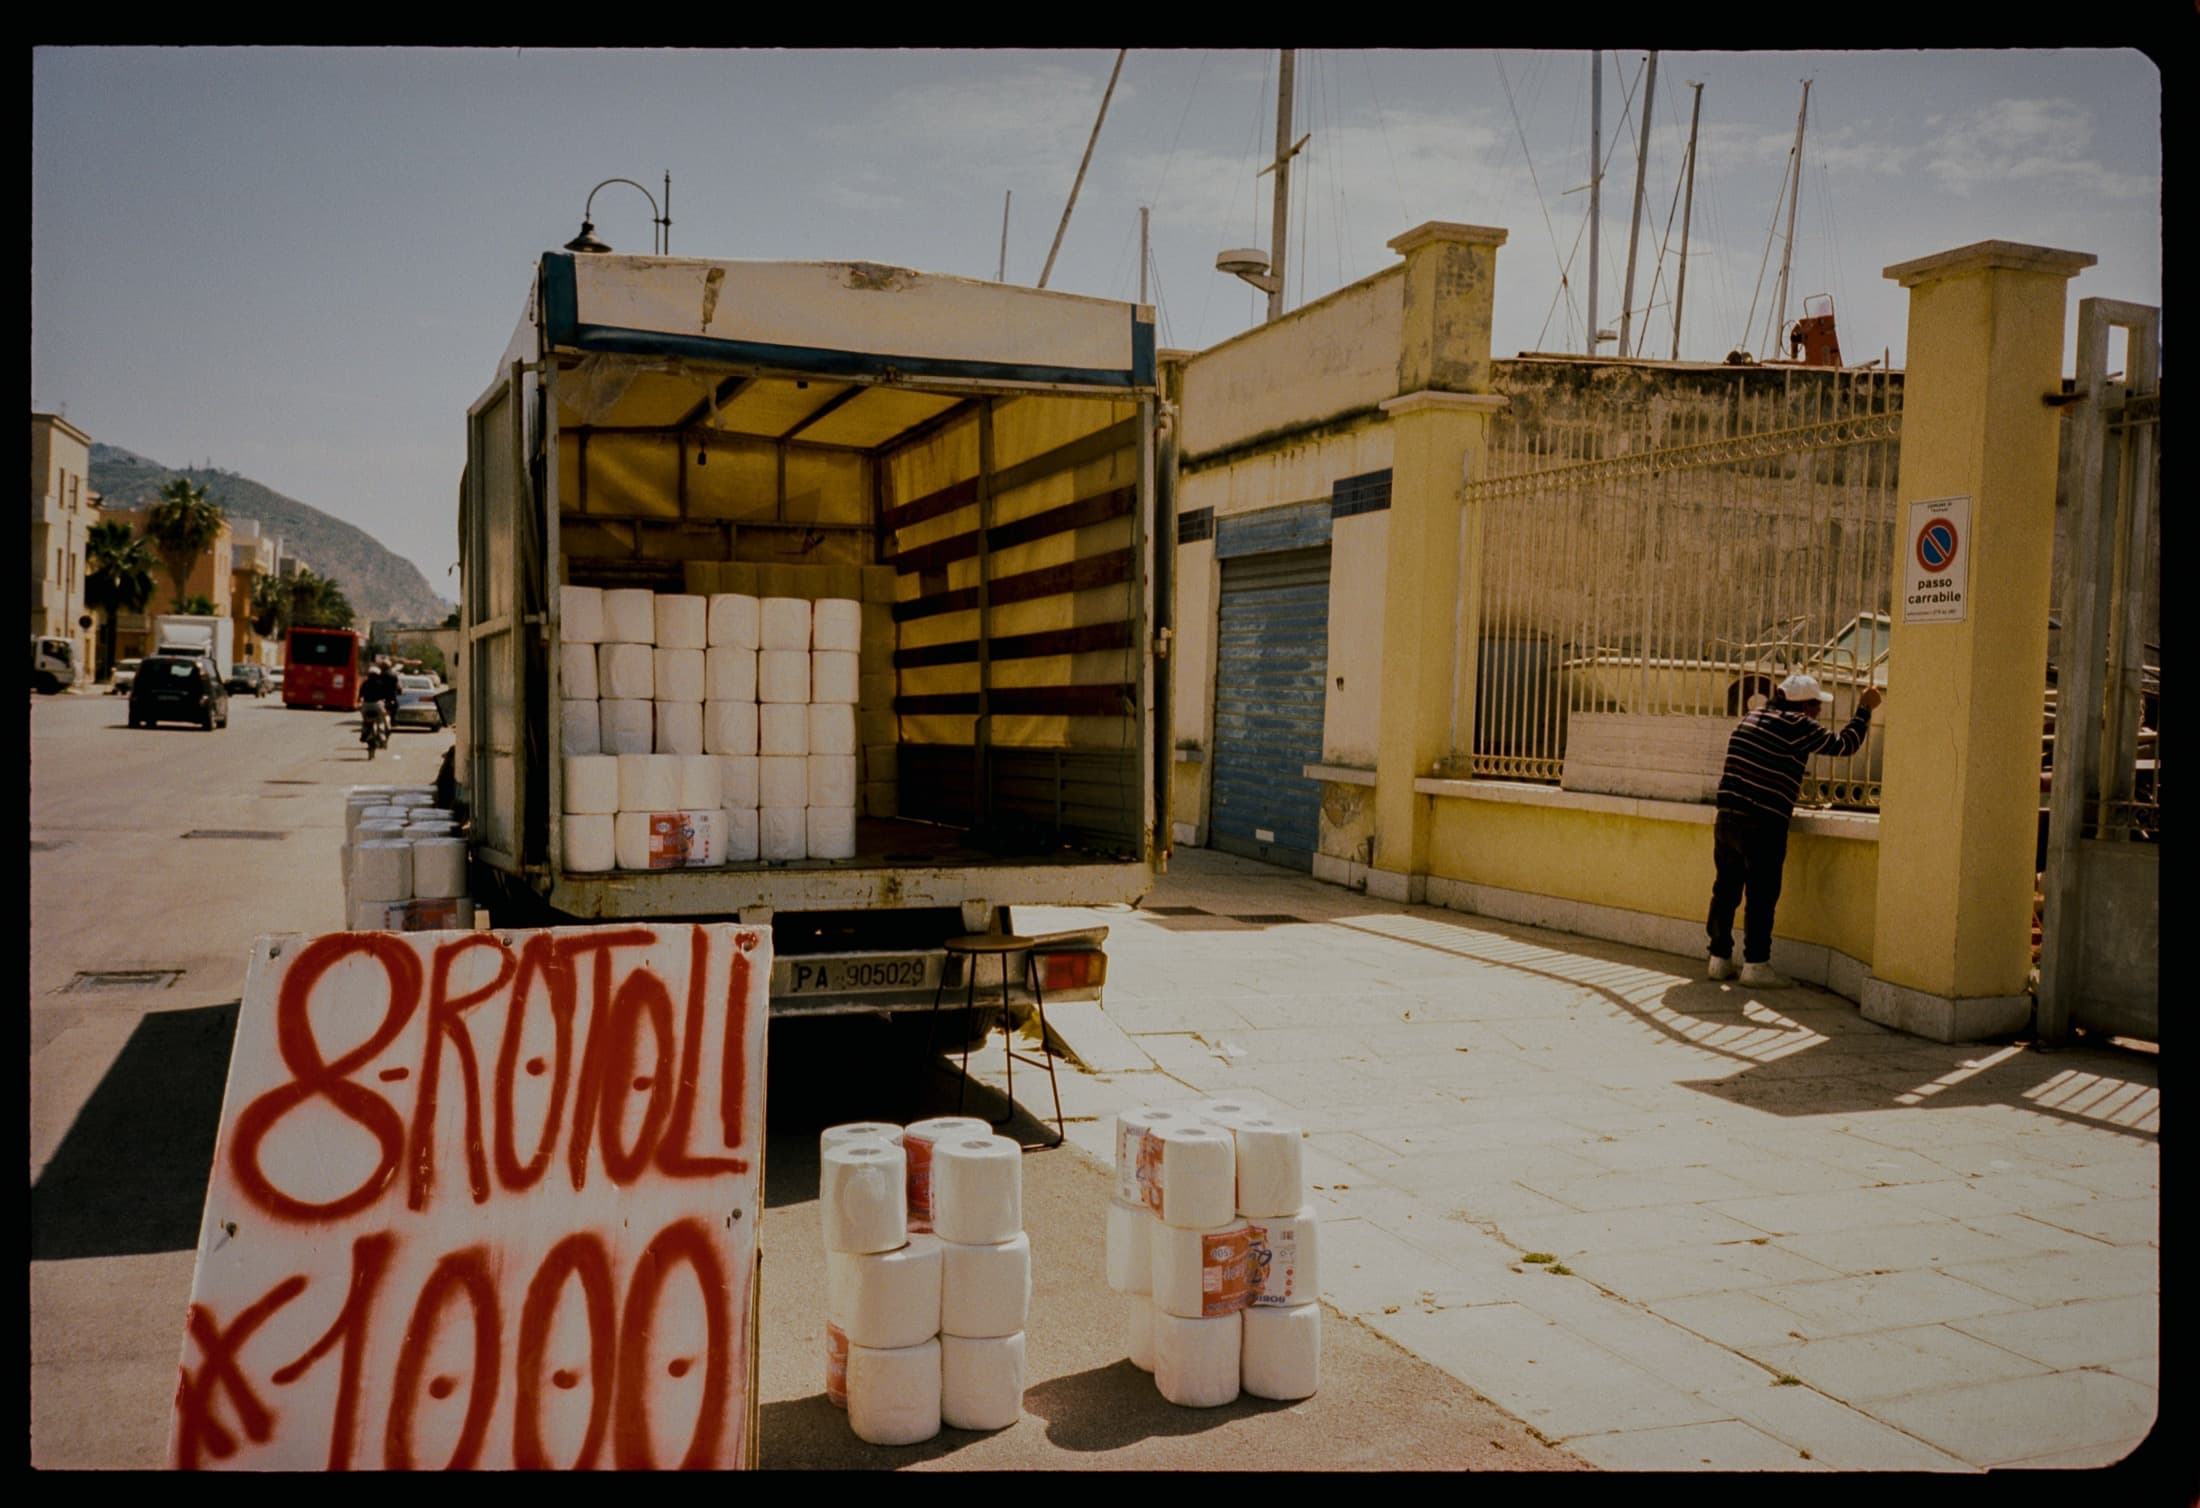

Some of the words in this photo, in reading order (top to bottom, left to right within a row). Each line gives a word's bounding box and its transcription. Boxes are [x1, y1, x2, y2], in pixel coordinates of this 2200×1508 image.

[1917, 578, 1952, 590] passo
[1908, 591, 1961, 605] carrabile
[797, 965, 829, 989] PA
[845, 959, 925, 987] 905029
